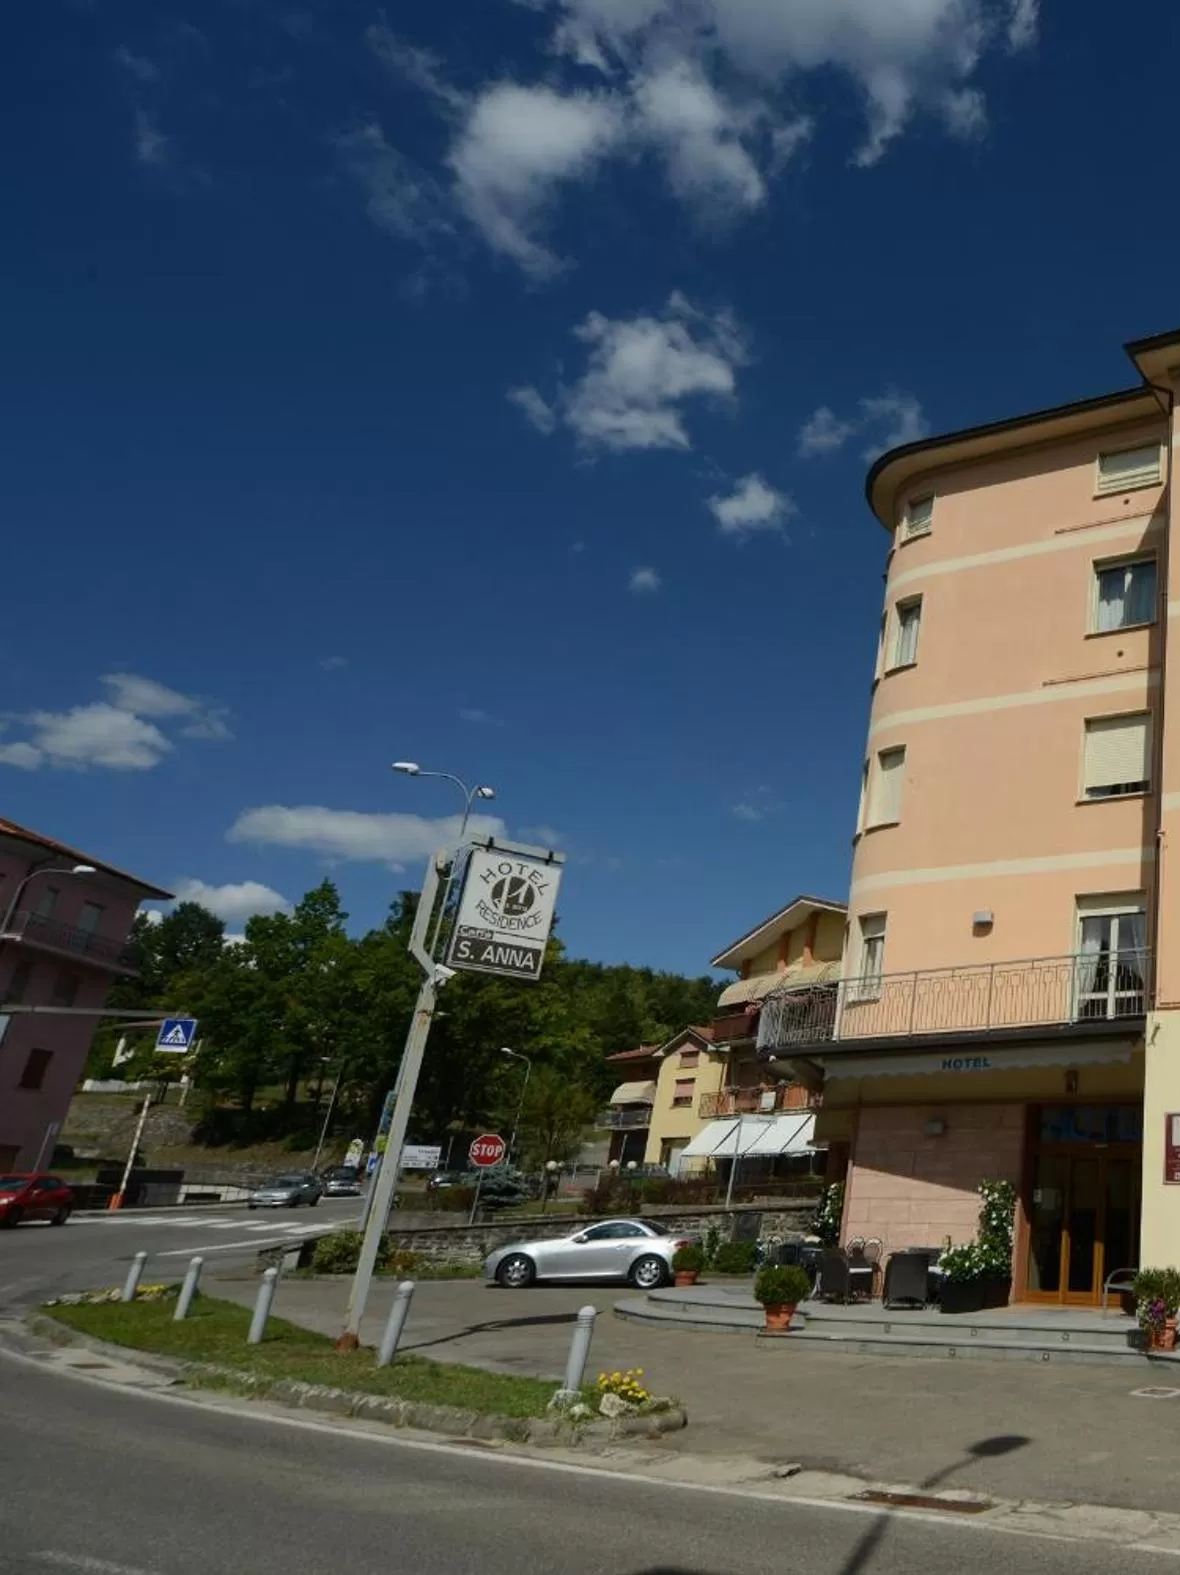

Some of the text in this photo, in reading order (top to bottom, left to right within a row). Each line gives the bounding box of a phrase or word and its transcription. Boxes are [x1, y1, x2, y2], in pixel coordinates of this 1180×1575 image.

[480, 862, 549, 895] HOTEL
[475, 899, 543, 930] RESIDENCE
[457, 941, 535, 969] S. ANNA
[941, 1056, 992, 1069] HOTEL
[473, 1143, 503, 1157] STOP
